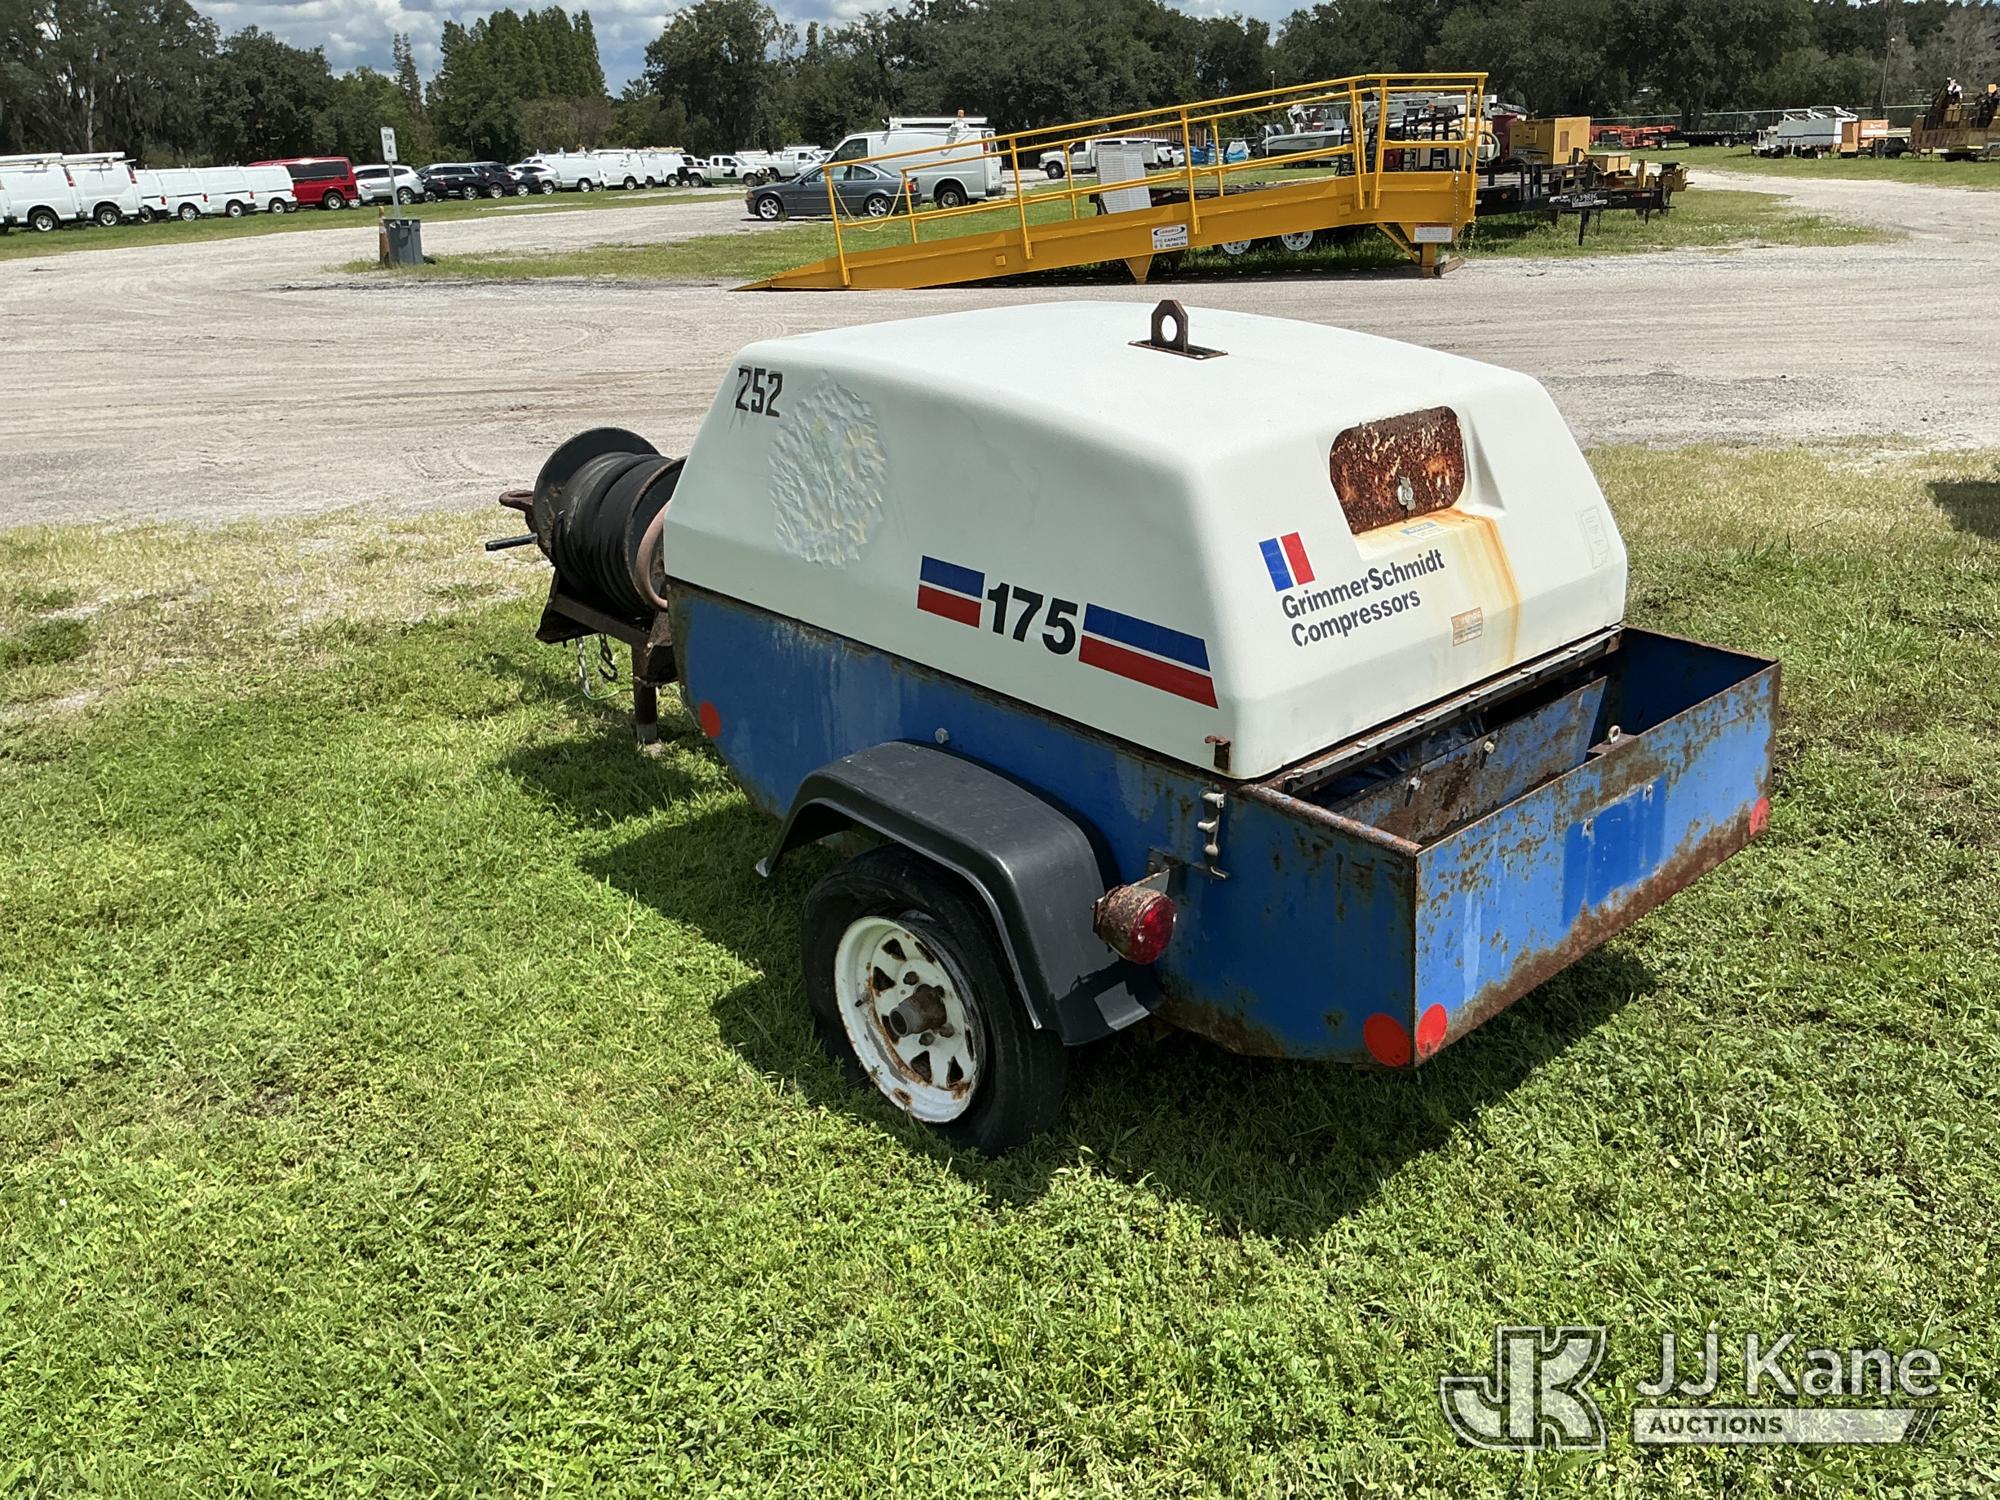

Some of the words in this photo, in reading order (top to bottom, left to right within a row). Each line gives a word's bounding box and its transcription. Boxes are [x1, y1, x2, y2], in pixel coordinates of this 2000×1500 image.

[736, 365, 783, 418] 252
[1282, 549, 1445, 619] GrimmerSchmidt
[987, 582, 1078, 655] 175
[1291, 590, 1421, 647] Compressors
